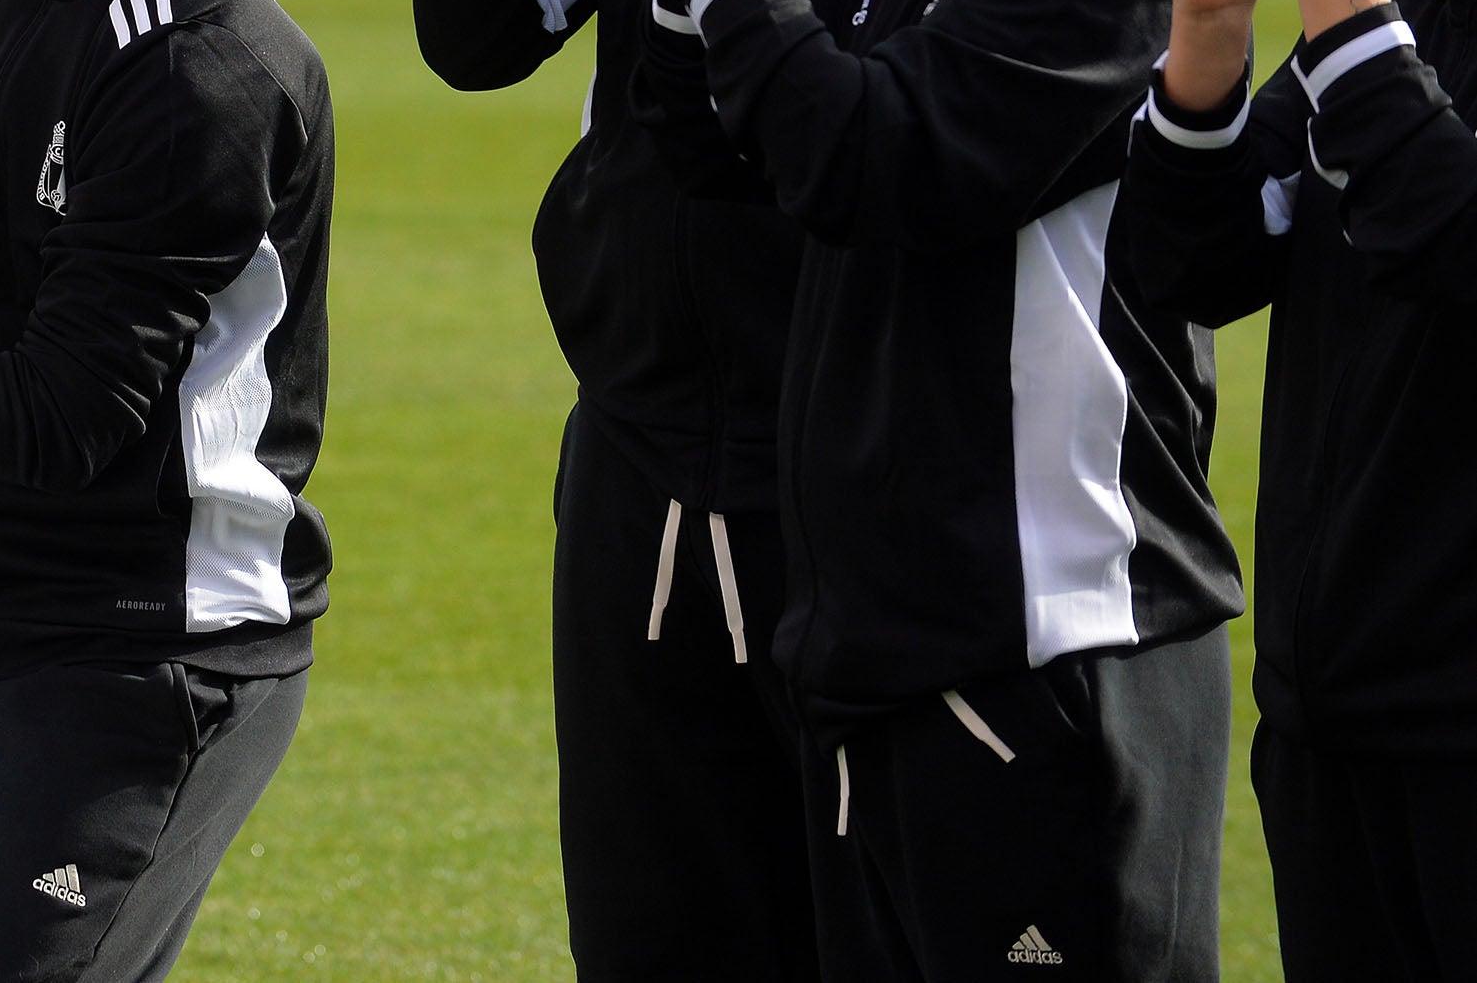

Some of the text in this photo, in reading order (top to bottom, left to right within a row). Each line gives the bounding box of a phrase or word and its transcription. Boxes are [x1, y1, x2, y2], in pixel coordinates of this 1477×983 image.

[115, 599, 166, 611] AEROREADY
[32, 878, 87, 907] adidas
[1007, 948, 1064, 965] adidas
